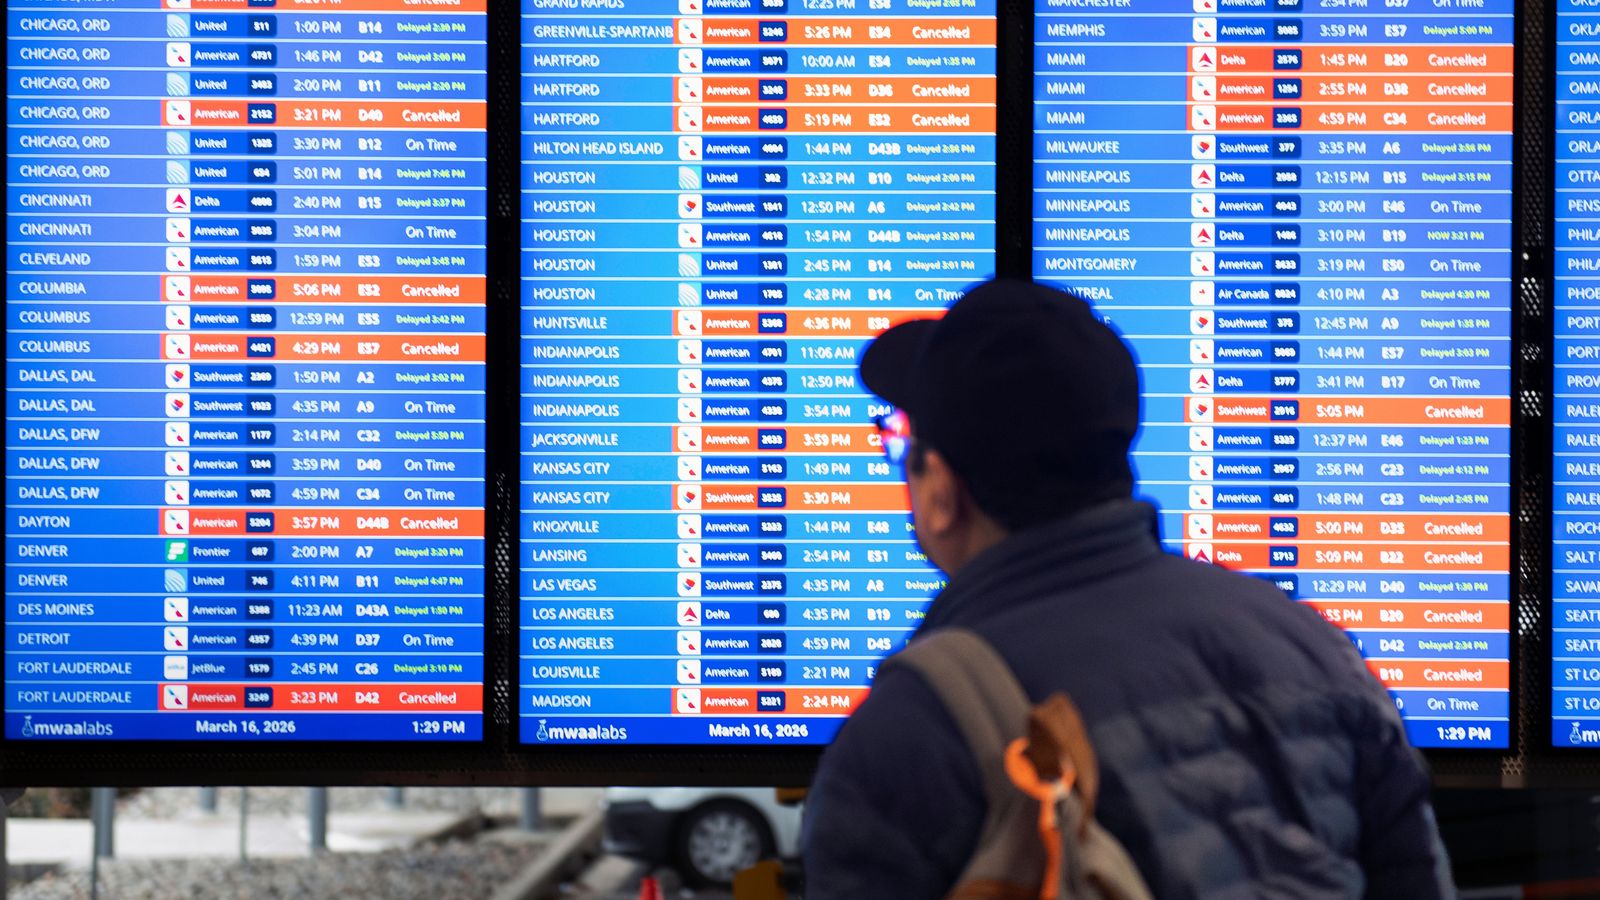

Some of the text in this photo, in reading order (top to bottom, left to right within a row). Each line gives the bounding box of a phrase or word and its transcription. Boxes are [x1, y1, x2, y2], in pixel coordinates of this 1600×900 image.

[20, 18, 342, 34] CHICAGO, ORD United 1:00 PM
[804, 25, 831, 39] 5:26
[832, 25, 852, 39] PM
[911, 25, 971, 39] Cancelled
[1047, 23, 1106, 37] MEMPHIS
[1319, 24, 1346, 37] 3:59
[1347, 24, 1368, 37] PM
[1423, 25, 1459, 37] Delayed
[1478, 25, 1493, 35] PM
[533, 54, 600, 67] HARTFORD
[1047, 53, 1487, 67] MIAMI Delta 1:45 PM Cancelled
[20, 106, 461, 122] CHICAGO, ORD American Cancelled
[533, 141, 852, 155] HILTON HEAD ISLAND American 1:44 PM
[1046, 140, 1120, 154] MILWAUKEE
[1219, 142, 1269, 153] Southwest
[1382, 141, 1401, 154] A6
[1046, 170, 1131, 183] MINNEAPOLIS
[19, 194, 92, 207] CINCINNATI
[194, 195, 221, 207] Delta
[293, 196, 320, 209] 2:40
[321, 196, 342, 209] PM
[396, 197, 432, 209] Delayed
[451, 198, 466, 208] PM
[533, 200, 886, 214] HOUSTON Southwest A6
[1427, 231, 1451, 241] NOW
[1470, 231, 1485, 241] PM
[533, 258, 596, 272] HOUSTON
[706, 259, 738, 271] United
[803, 259, 830, 272] 2:45
[831, 259, 852, 272] PM
[867, 259, 892, 272] B14
[906, 260, 941, 272] Delayed
[960, 260, 975, 270] PM
[1045, 257, 1482, 272] MONTGOMERY American 3:19 PM On Time
[19, 281, 460, 297] COLUMBIA Cancelled
[1217, 287, 1400, 301] Air Canada A3
[533, 316, 607, 330] HUNTSVILLE
[19, 340, 91, 353] COLUMBUS
[533, 345, 855, 359] INDIANAPOLIS American 11:06 AM
[19, 369, 244, 384] DALLAS, DAL Southwest
[1217, 405, 1484, 419] Southwest Cancelled
[292, 429, 319, 442] 2:14
[320, 429, 340, 442] PM
[531, 433, 619, 448] JACKSONVILLE
[533, 462, 610, 475] KANSAS CITY
[18, 515, 459, 530] DAYTON American Cancelled
[532, 520, 600, 533] KNOXVILLE
[1216, 521, 1483, 536] American 5:00 PM Cancelled
[192, 545, 374, 559] Frontier A7
[532, 549, 889, 563] LANSING 2:54 PM E51
[1565, 551, 1594, 563] SALT
[18, 574, 68, 587] DENVER
[291, 575, 316, 587] 4:11
[319, 575, 340, 588] PM
[394, 576, 430, 588] Delayed
[449, 576, 464, 586] PM
[532, 578, 754, 592] LAS VEGAS Southwest
[532, 607, 615, 621] LOS ANGELES
[18, 632, 71, 645] DETROIT
[191, 634, 237, 644] American
[290, 633, 317, 646] 4:39
[318, 633, 339, 646] PM
[355, 633, 381, 646] D37
[402, 633, 422, 646] On
[423, 633, 454, 647] Time
[18, 661, 132, 674] FORT LAUDERDALE
[532, 665, 600, 679] LOUISVILLE
[1565, 668, 1581, 681] ST
[532, 694, 850, 708] MADISON American 2:24 PM
[1427, 697, 1480, 711] On Time
[1565, 698, 1581, 711] ST
[34, 721, 114, 736] mwaalabs
[195, 719, 296, 735] March 16, 2026
[412, 720, 465, 734] 1:29 PM
[548, 724, 627, 740] mwaalabs
[708, 723, 809, 740] March 16, 2026
[1437, 726, 1492, 741] 1:29 PM
